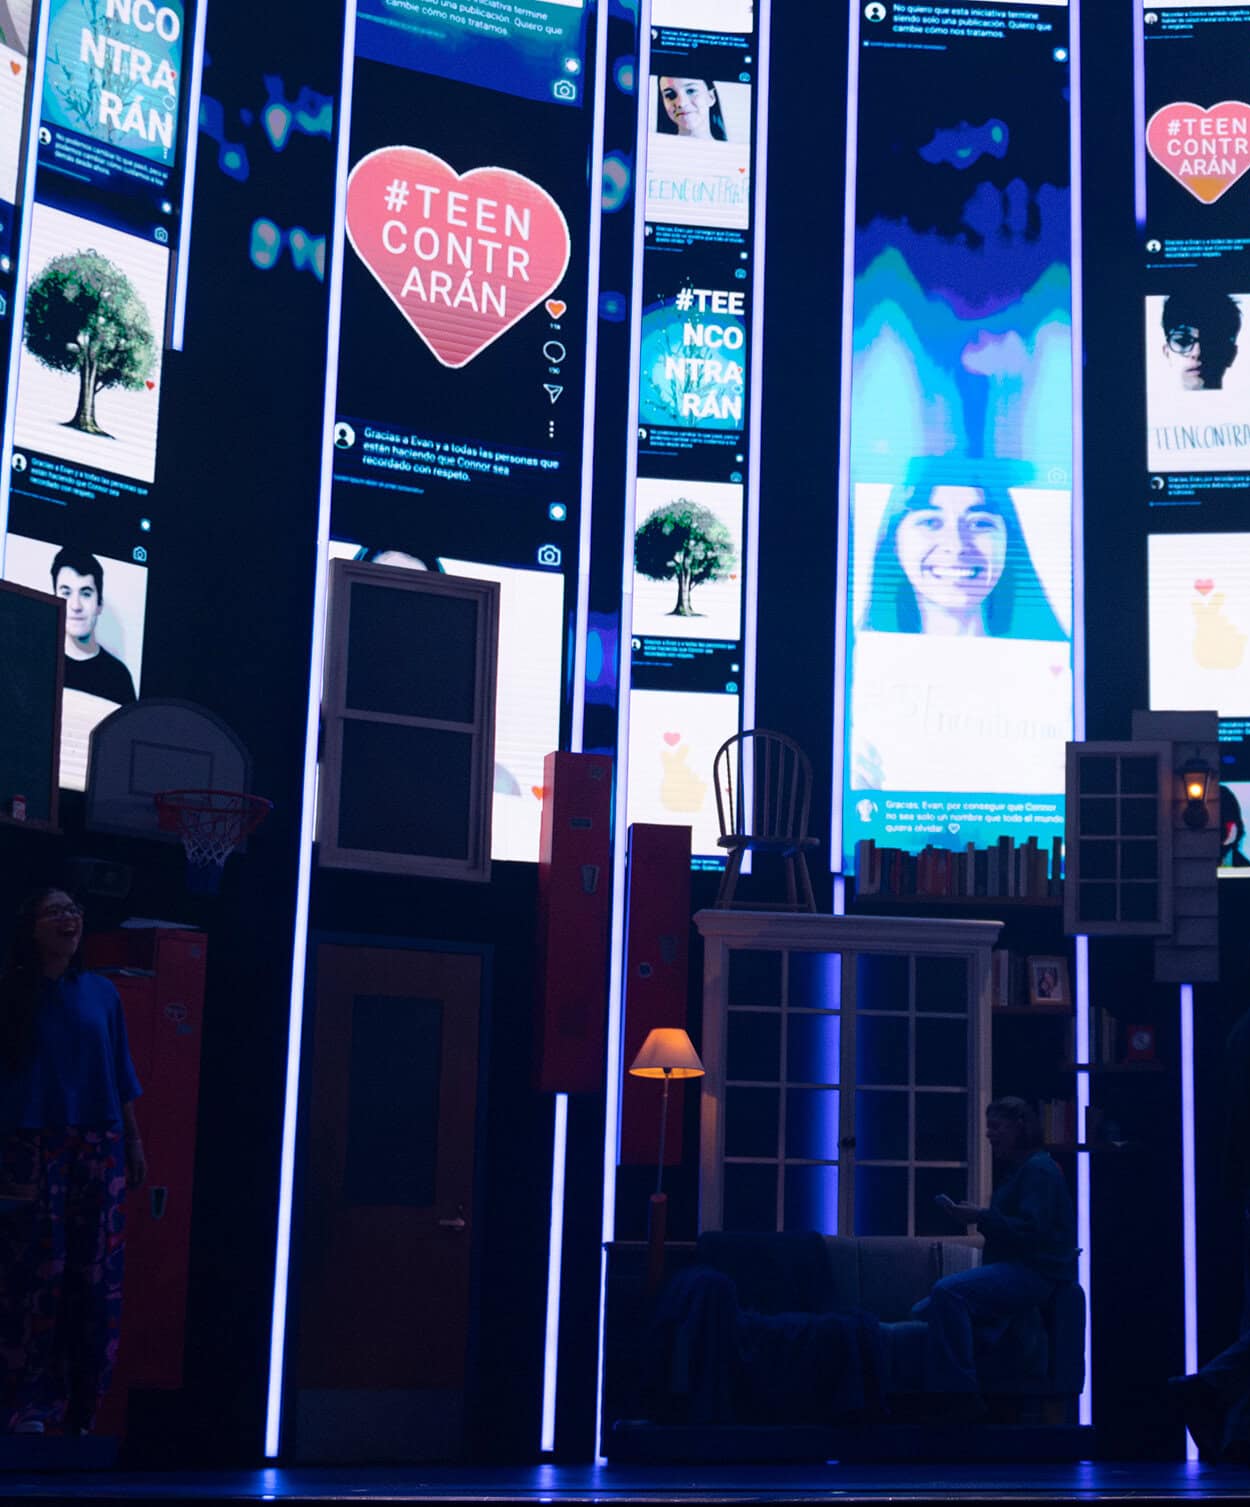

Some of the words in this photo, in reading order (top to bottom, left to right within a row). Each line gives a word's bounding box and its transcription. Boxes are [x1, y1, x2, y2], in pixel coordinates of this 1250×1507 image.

[106, 0, 180, 42] NCO
[422, 7, 447, 19] cómo
[449, 14, 466, 24] nos
[441, 1, 457, 10] una
[514, 17, 543, 31] Quiero
[545, 26, 563, 35] que
[514, 6, 548, 20] termine
[893, 4, 906, 12] No
[971, 10, 1007, 18] iniciativa
[1008, 11, 1039, 20] termine
[893, 15, 921, 23] siendo
[922, 16, 940, 24] solo
[1008, 20, 1036, 30] Quiero
[924, 26, 949, 34] cómo
[80, 28, 177, 95] NTRA
[99, 85, 173, 148] RÁN
[1167, 117, 1248, 136] #TEEN
[1166, 138, 1249, 156] CONTR
[1179, 155, 1238, 176] ARÁN
[384, 178, 531, 241] #TEEN
[382, 220, 530, 282] CONTR
[401, 266, 507, 318] ARÁN
[675, 288, 745, 316] #TEE
[683, 322, 743, 350] NCO
[664, 357, 743, 385] NTRA
[679, 389, 742, 420] RÁN
[363, 442, 390, 453] están
[392, 446, 436, 462] haciendo
[437, 455, 455, 465] que
[457, 457, 491, 471] Connor
[493, 465, 509, 475] sea
[364, 428, 401, 442] Gracias
[411, 436, 434, 448] Evan
[451, 444, 477, 456] todas
[479, 448, 493, 459] las
[495, 453, 538, 466] personas
[540, 459, 559, 469] que
[363, 456, 411, 471] recordado
[413, 464, 432, 474] con
